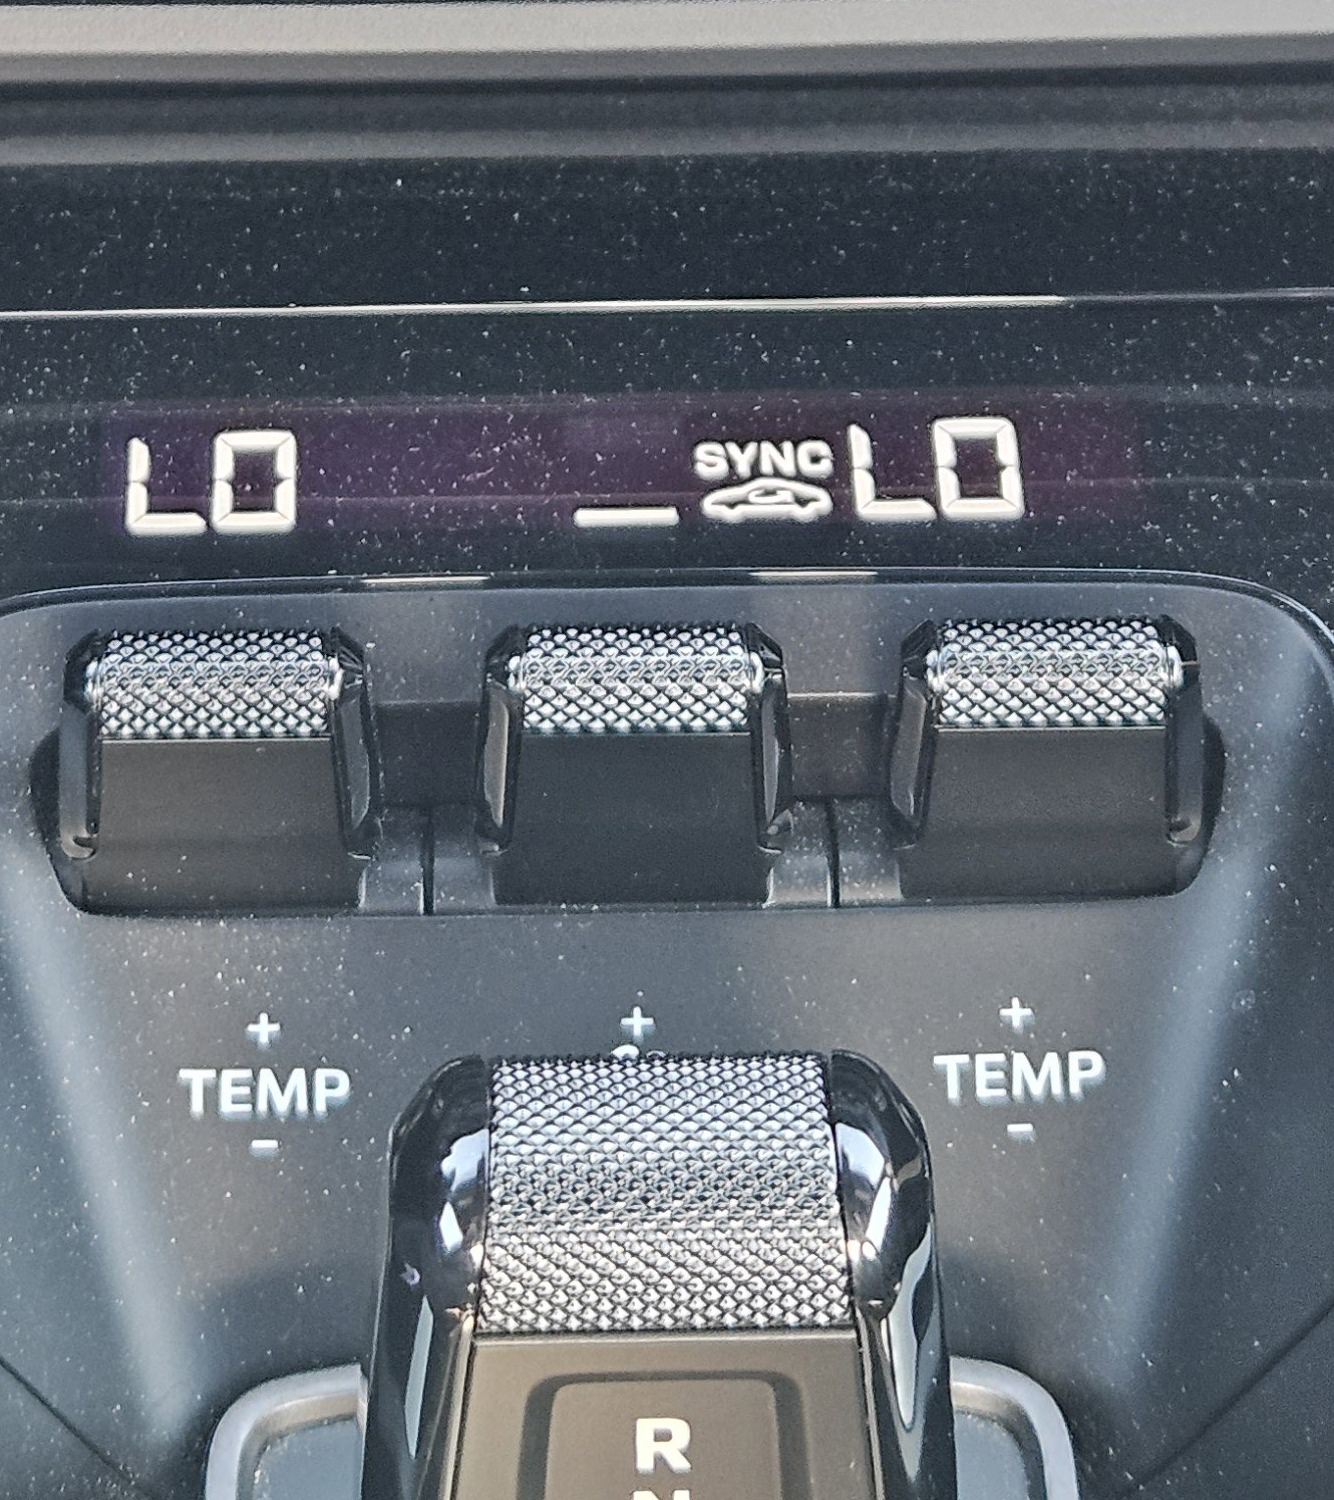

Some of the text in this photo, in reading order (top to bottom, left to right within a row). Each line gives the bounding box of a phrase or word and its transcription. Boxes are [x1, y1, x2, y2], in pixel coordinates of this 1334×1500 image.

[125, 429, 298, 535] LO
[693, 439, 833, 478] SYNC
[847, 415, 1025, 523] LO
[177, 1066, 351, 1120] TEMP
[931, 1048, 1107, 1104] TEMP
[634, 1416, 693, 1475] R
